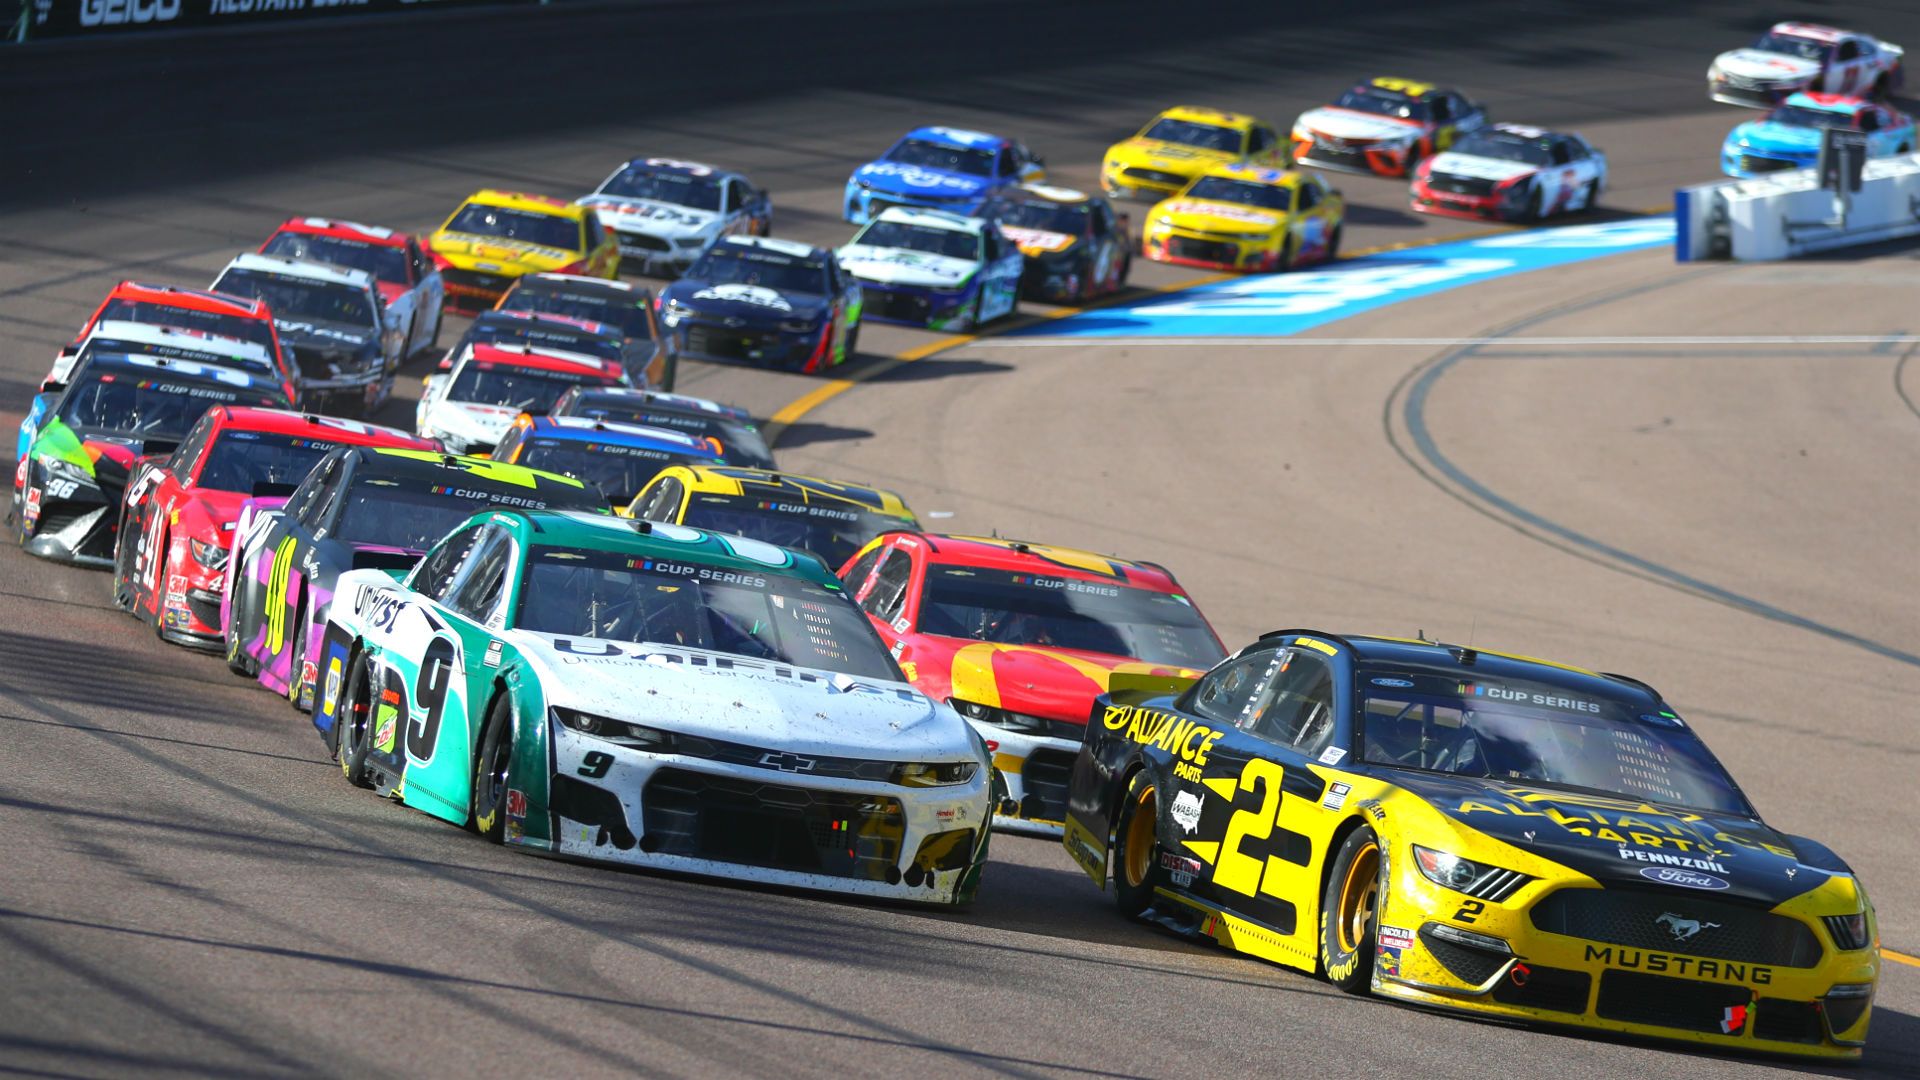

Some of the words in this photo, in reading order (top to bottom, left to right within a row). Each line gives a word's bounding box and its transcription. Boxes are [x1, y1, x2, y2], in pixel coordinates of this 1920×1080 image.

[159, 384, 188, 395] CUP
[189, 388, 237, 401] SERIES
[603, 445, 628, 455] CUP
[629, 448, 670, 461] SERIES
[47, 477, 80, 500] 96
[455, 488, 488, 500] CUP
[490, 494, 547, 510] SERIES
[778, 502, 808, 513] CUP
[809, 507, 858, 522] SERIES
[655, 562, 695, 576] CUP
[699, 569, 767, 588] SERIES
[1034, 578, 1065, 590] CUP
[1067, 583, 1118, 598] SERIES
[303, 662, 319, 687] 3M
[407, 636, 455, 762] 9
[1487, 687, 1528, 702] CUP
[1532, 694, 1601, 714] SERIES
[1125, 708, 1225, 767] ALLIANCE
[576, 750, 616, 780] 9
[1172, 760, 1203, 784] PARTS
[507, 789, 527, 818] 3M
[1212, 757, 1284, 899] 2
[1618, 848, 1731, 875] PENNZOIL
[1451, 899, 1486, 924] 2
[1584, 943, 1773, 986] MUSTANG
